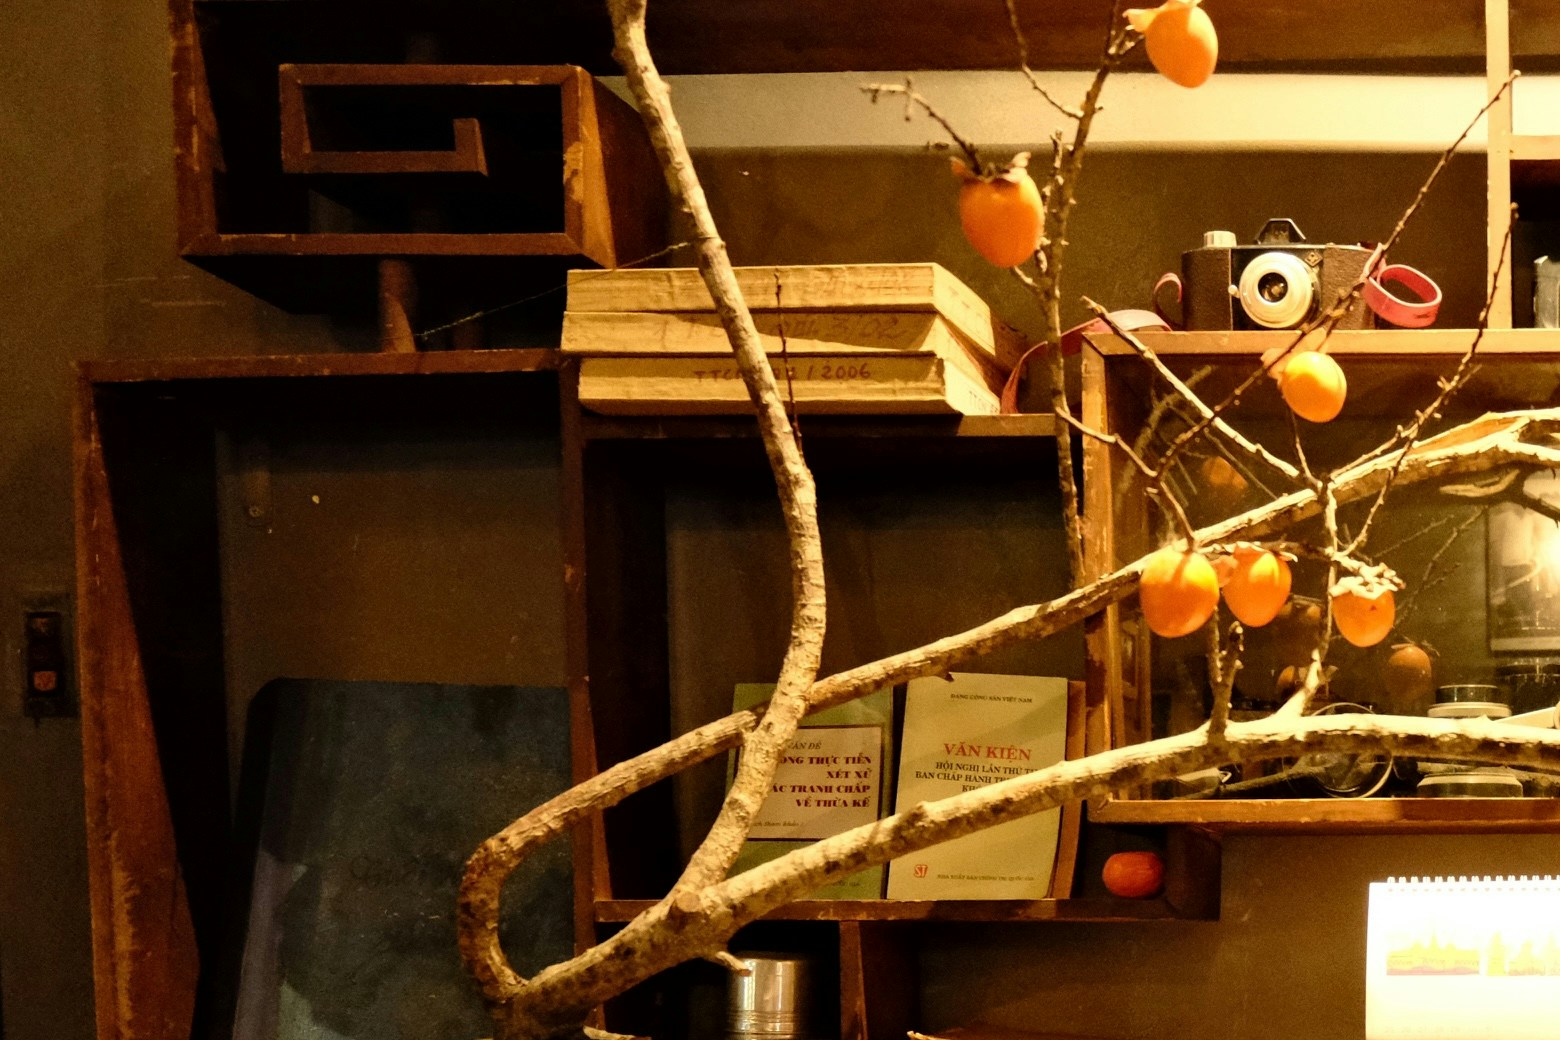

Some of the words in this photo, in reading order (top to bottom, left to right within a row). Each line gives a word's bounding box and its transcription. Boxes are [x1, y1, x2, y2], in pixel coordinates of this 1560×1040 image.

[943, 741, 982, 758] VĂN
[985, 744, 1033, 764] KIỆN
[935, 760, 954, 772] HỘI
[956, 762, 980, 774] NGHỊ
[915, 770, 935, 779] BAN
[790, 784, 833, 794] TRANH
